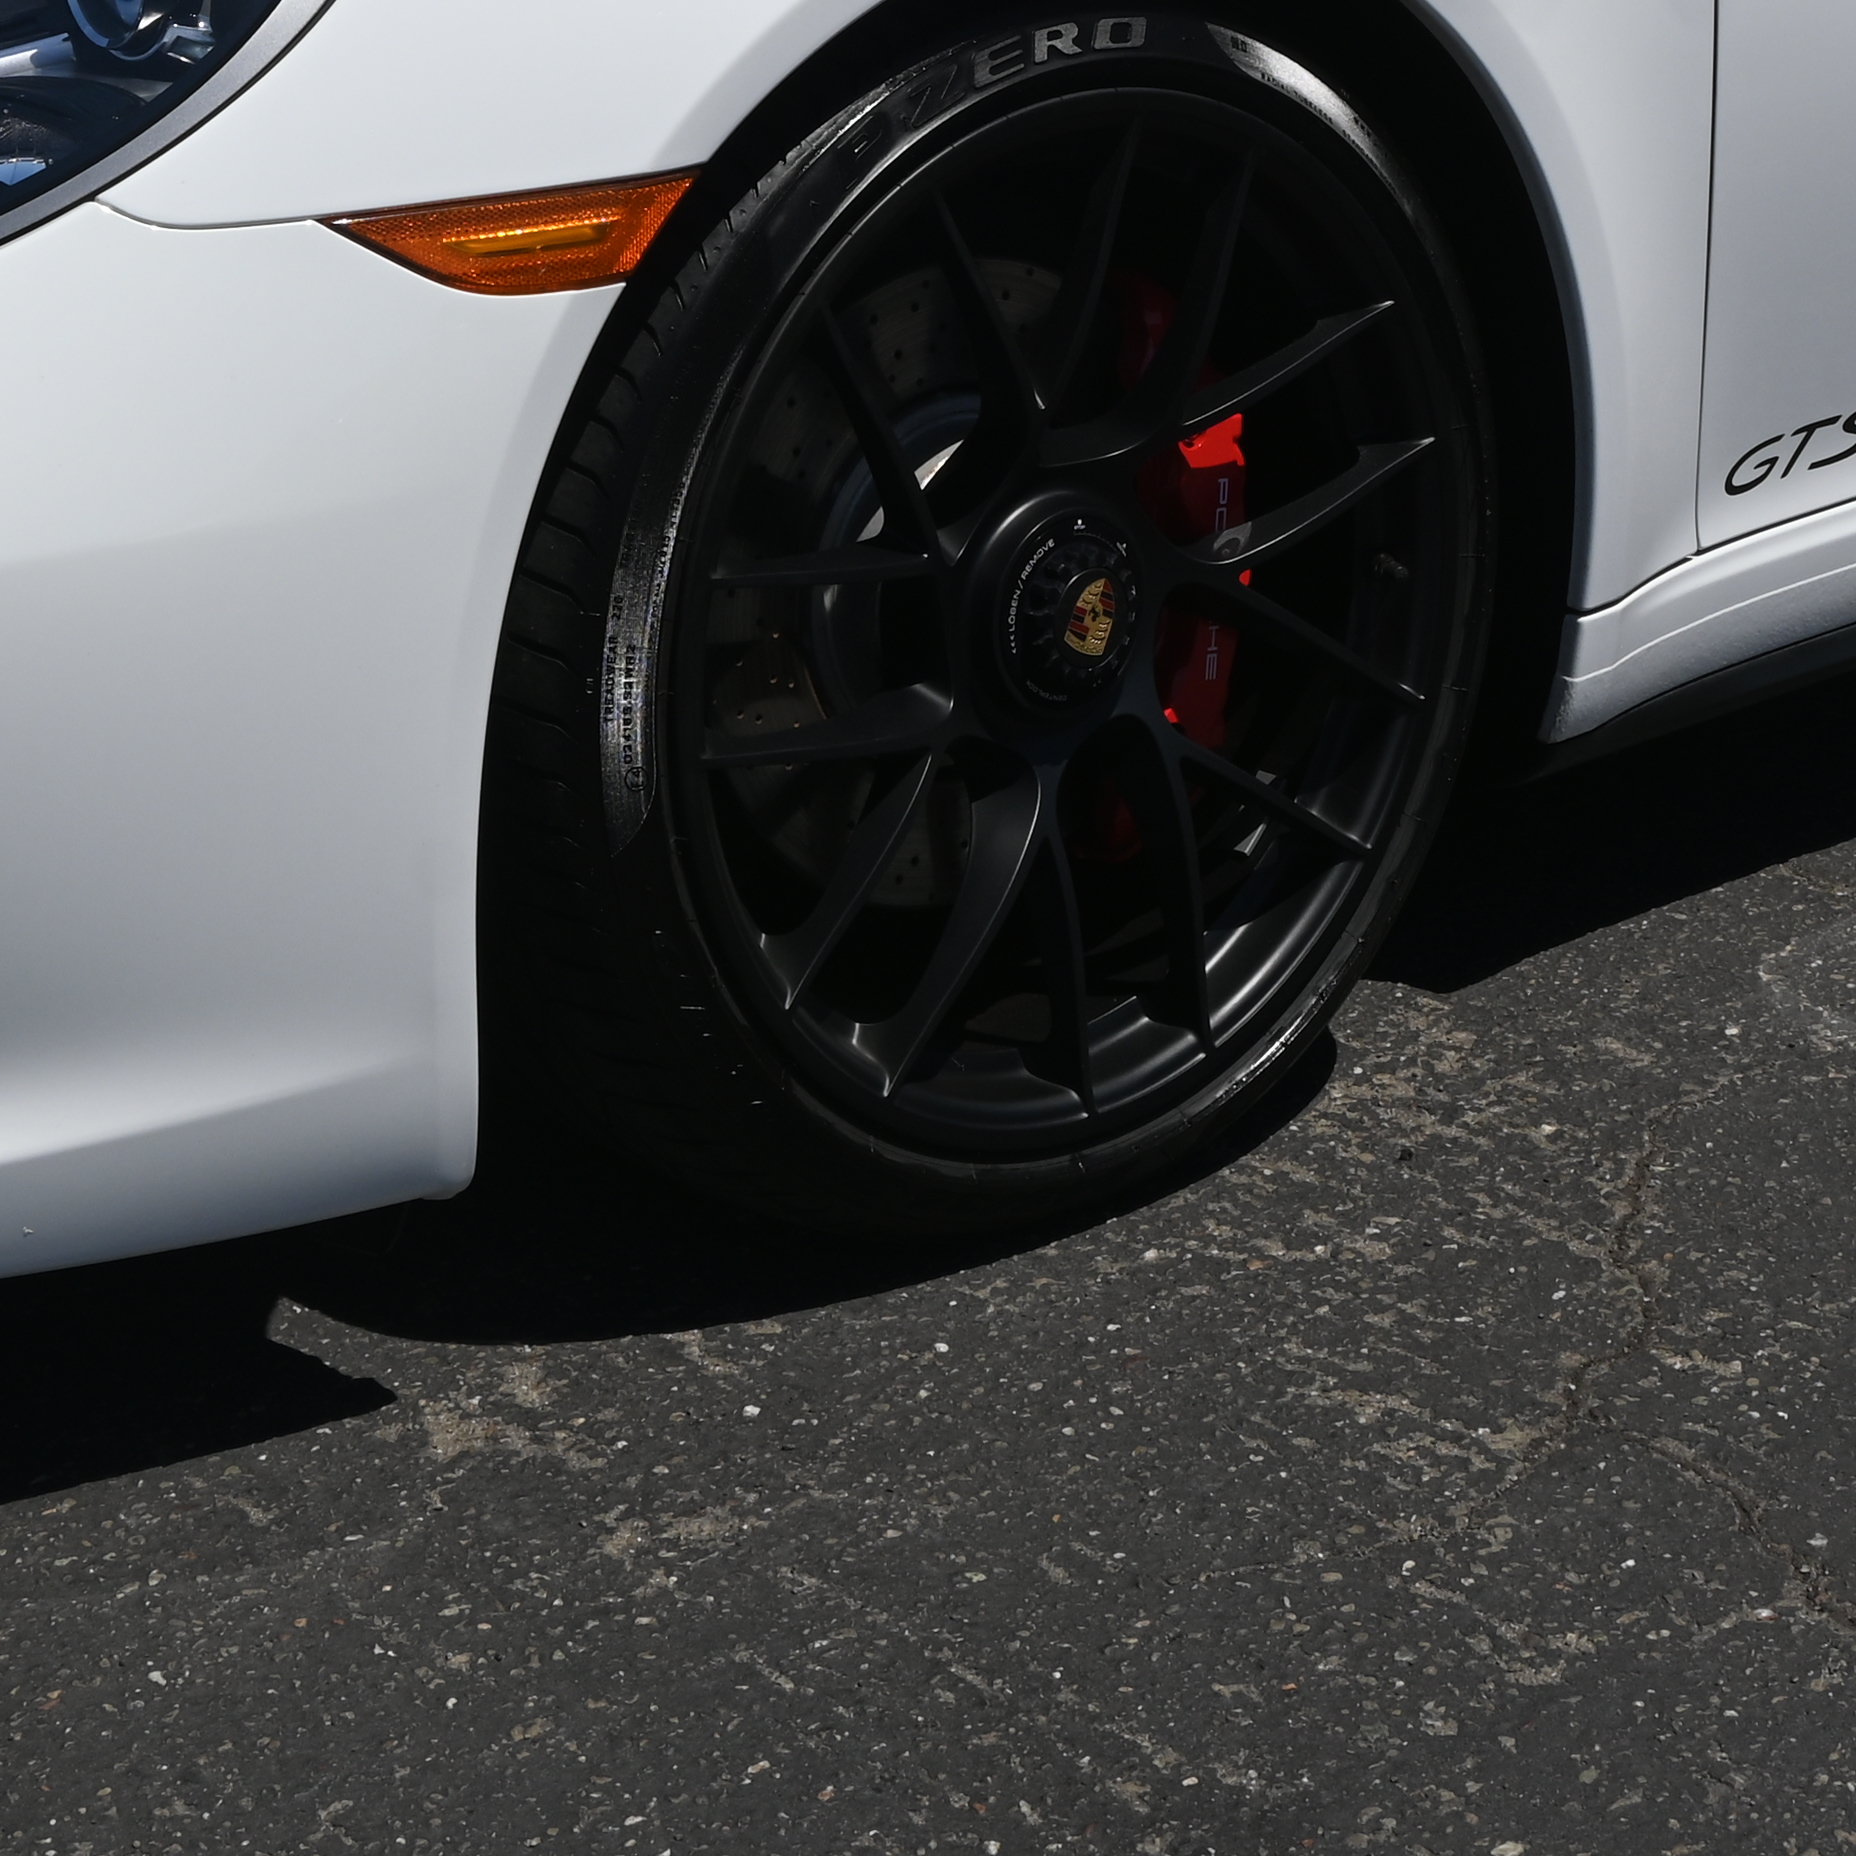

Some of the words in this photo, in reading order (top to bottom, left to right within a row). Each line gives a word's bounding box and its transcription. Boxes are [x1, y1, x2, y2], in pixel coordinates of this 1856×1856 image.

[901, 16, 1148, 132] ZERO
[1021, 538, 1056, 580] REMOVE
[604, 636, 618, 724] TREADWEAR
